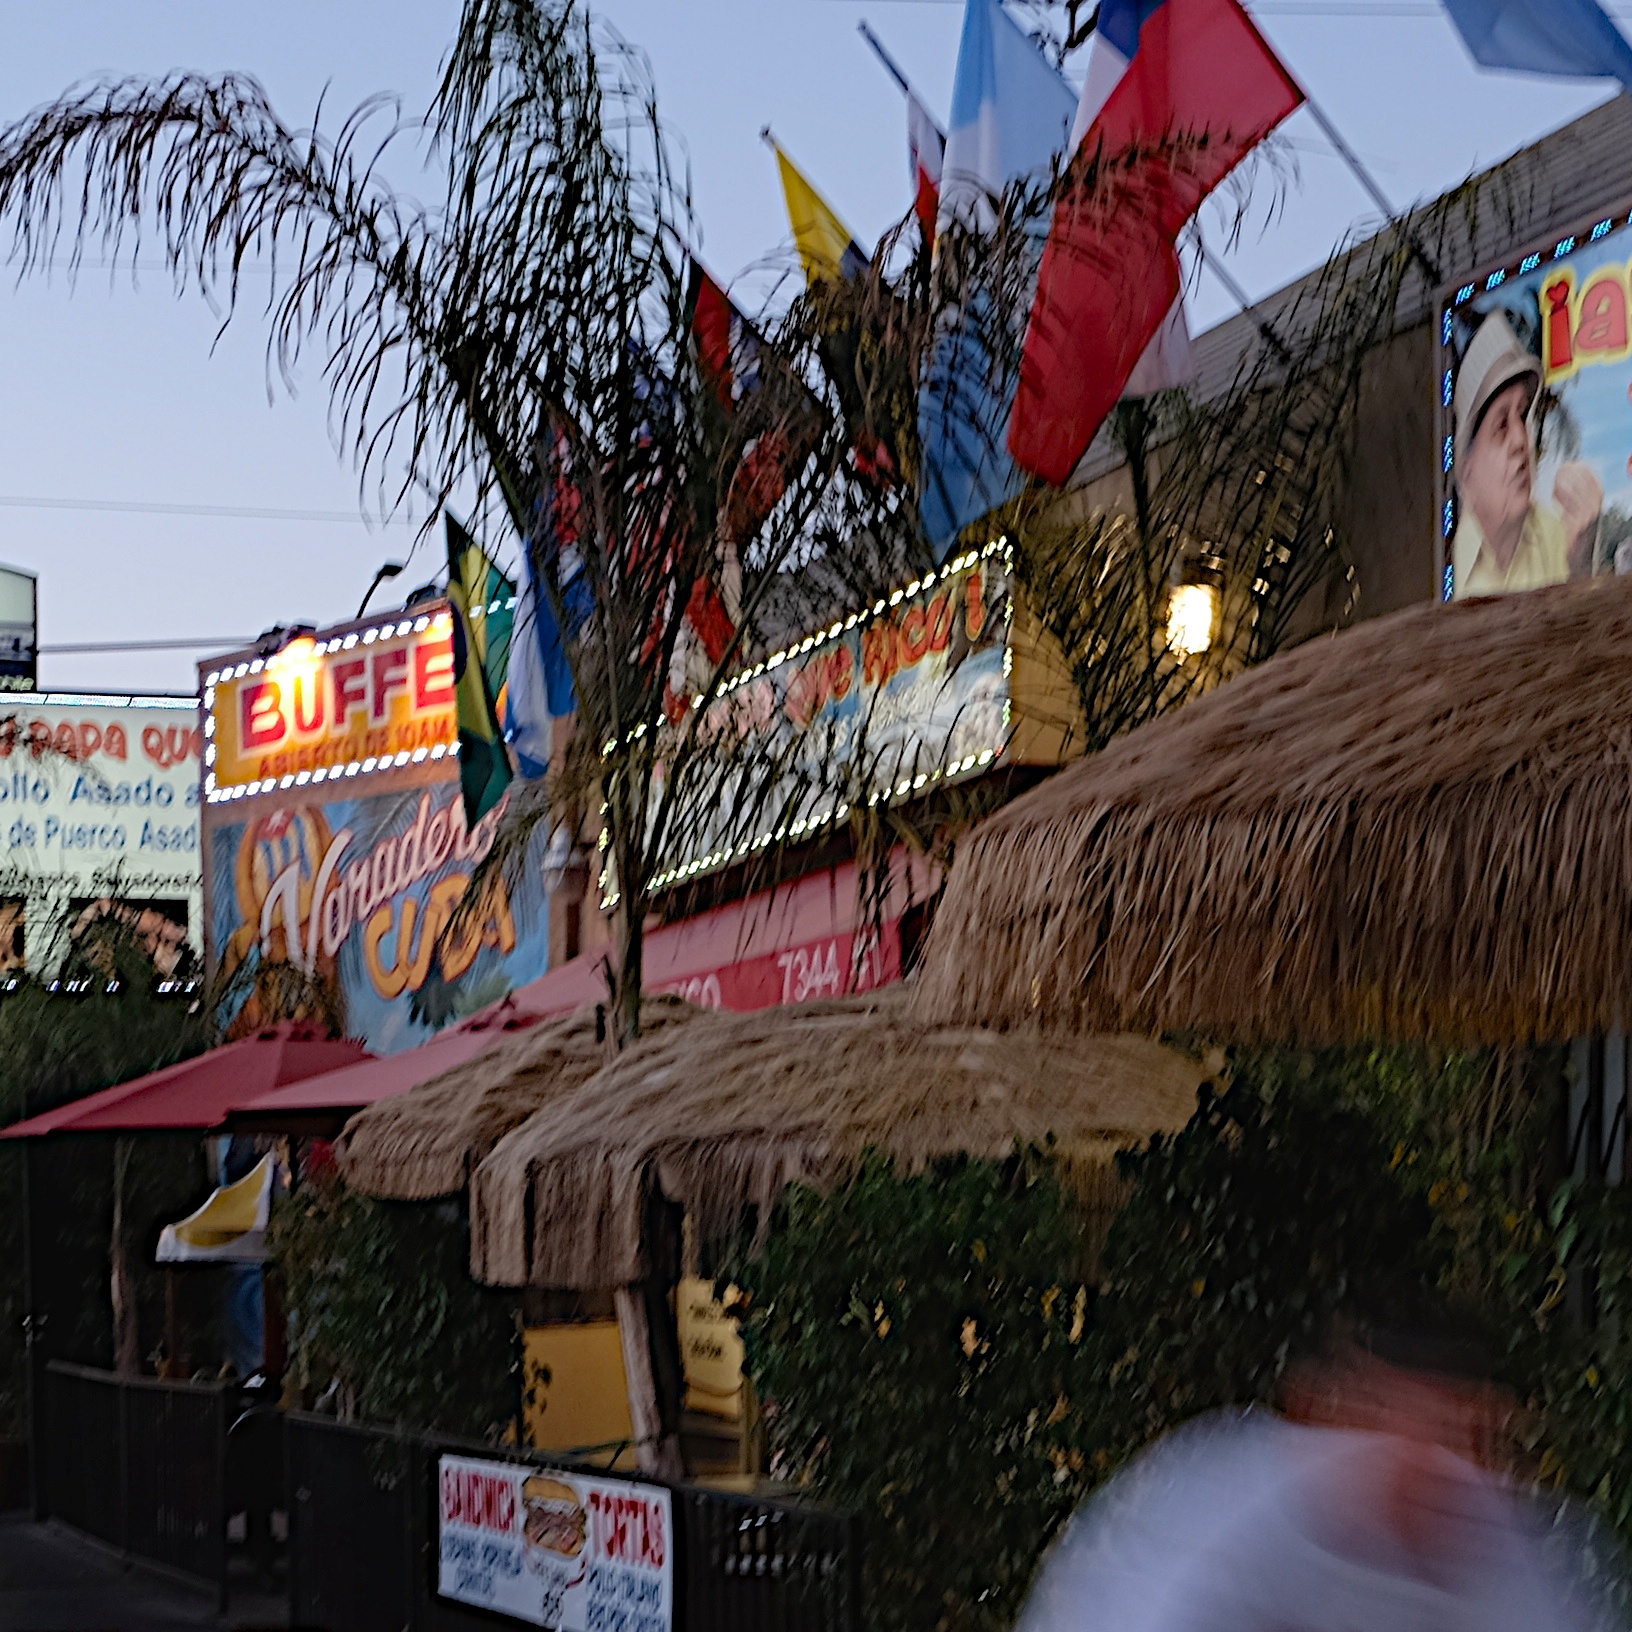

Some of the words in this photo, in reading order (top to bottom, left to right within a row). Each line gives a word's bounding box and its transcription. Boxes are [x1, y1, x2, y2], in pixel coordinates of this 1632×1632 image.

[238, 639, 457, 758] BUFFE
[68, 773, 174, 806] Asado
[8, 813, 37, 847] de
[45, 816, 126, 852] Puerco
[139, 818, 198, 851] Asad
[589, 1493, 665, 1571] TORTAS
